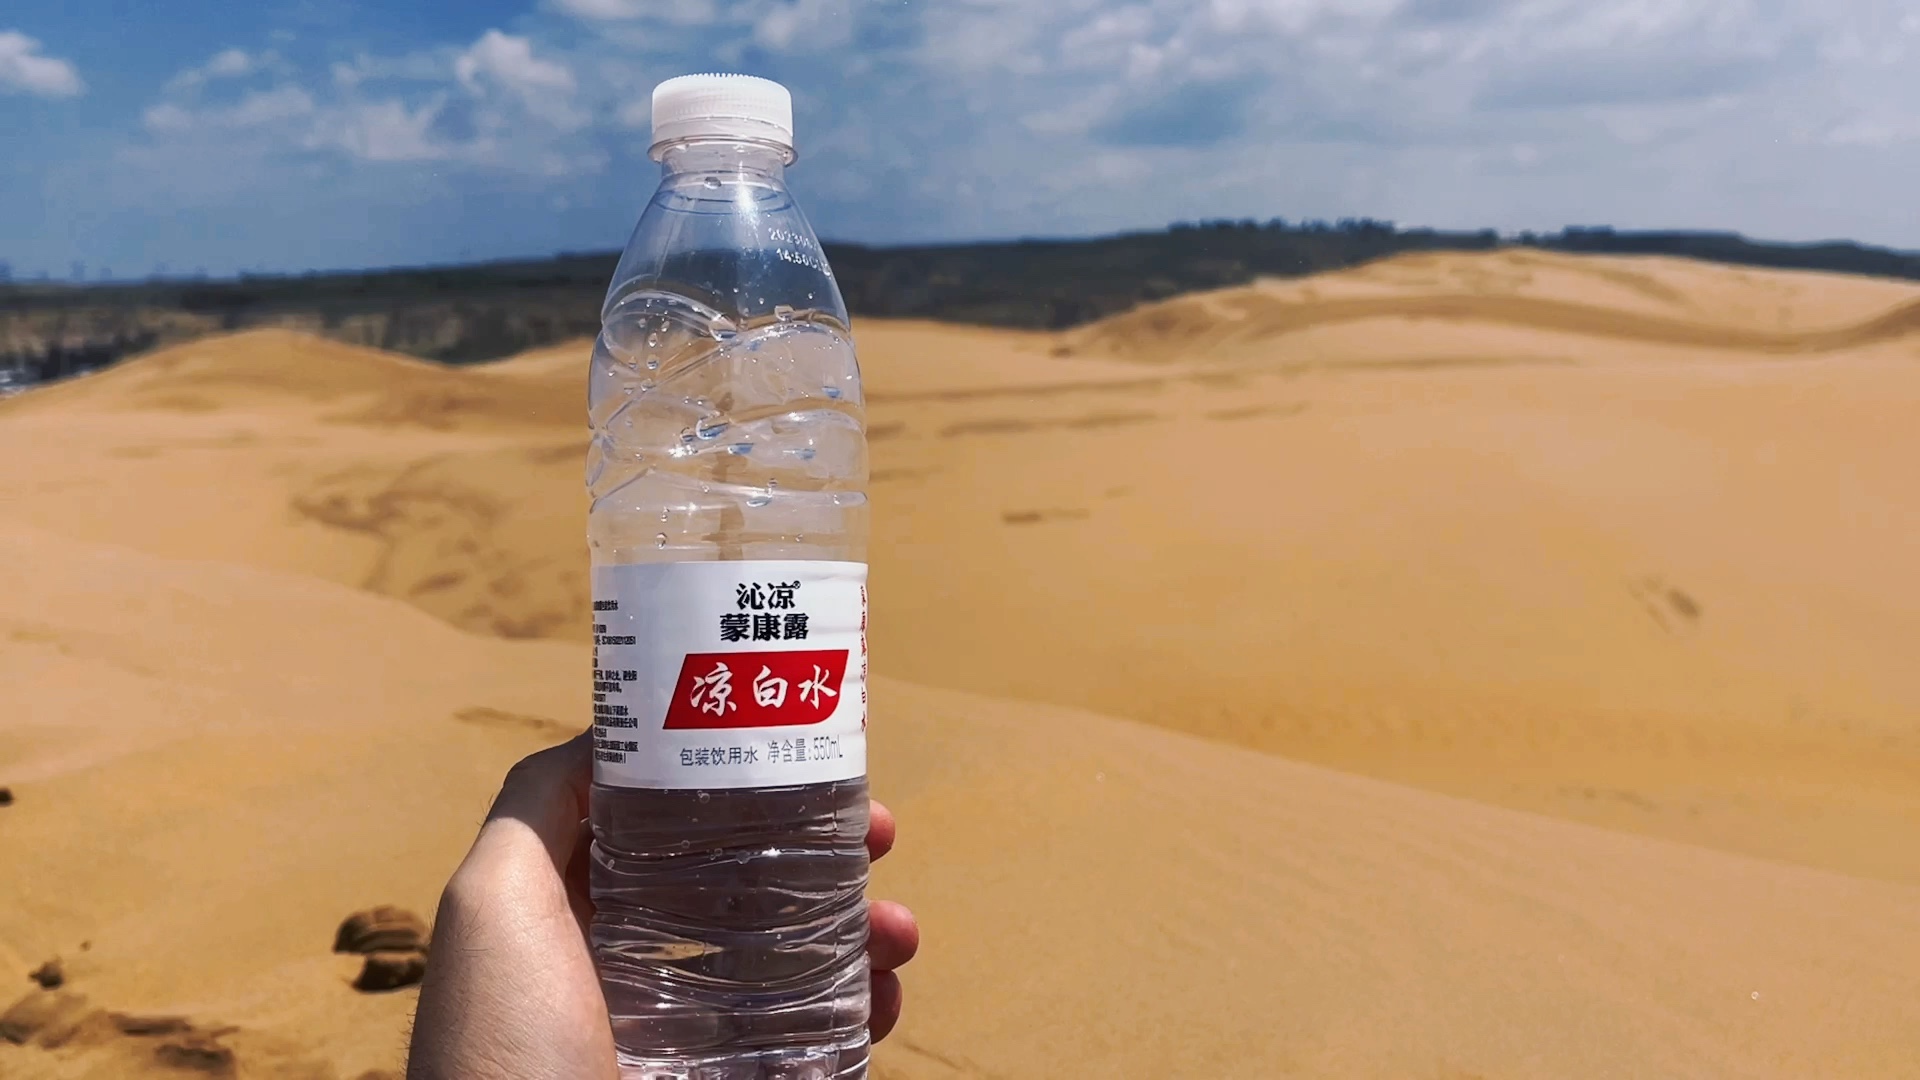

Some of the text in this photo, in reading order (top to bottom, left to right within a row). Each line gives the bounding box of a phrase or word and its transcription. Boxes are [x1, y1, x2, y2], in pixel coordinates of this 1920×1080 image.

[736, 580, 797, 610] 沁凉
[720, 612, 810, 642] 蒙康露
[690, 662, 838, 717] 凉白水
[679, 746, 759, 768] 包装饮用水
